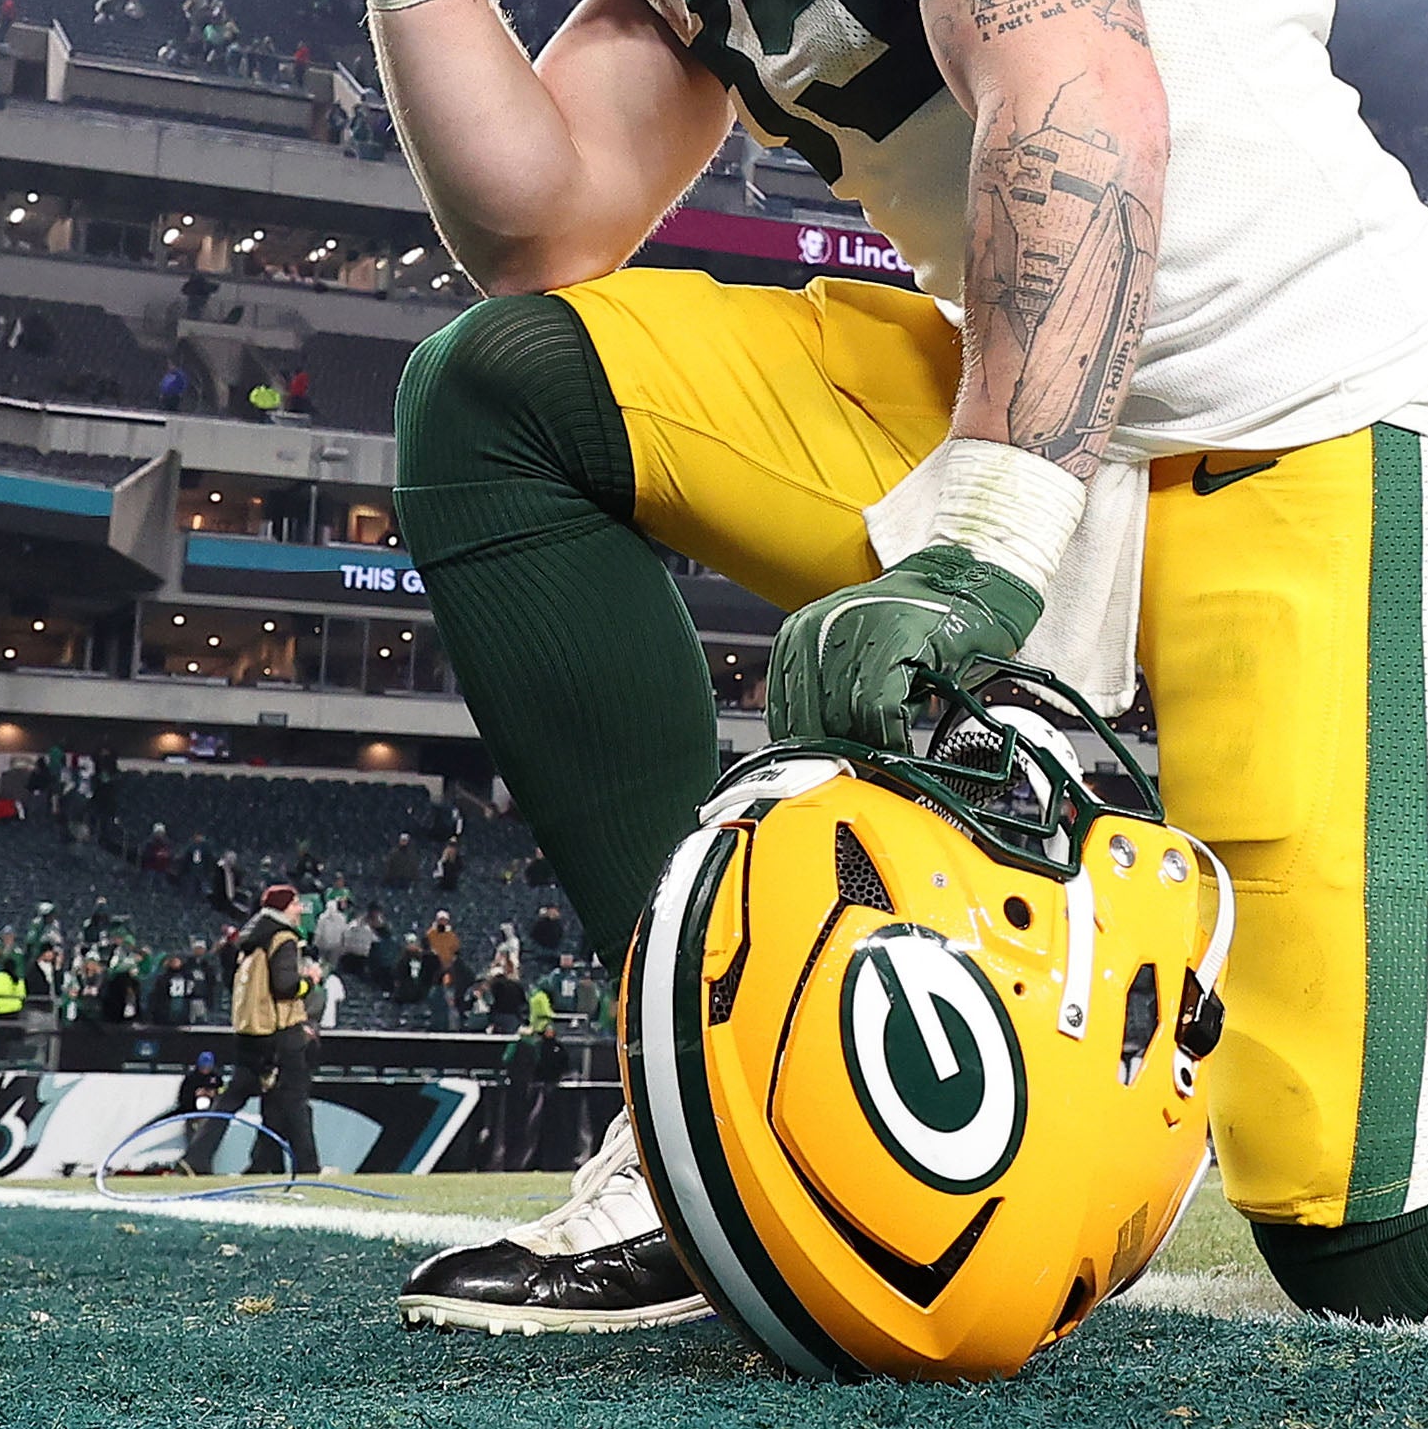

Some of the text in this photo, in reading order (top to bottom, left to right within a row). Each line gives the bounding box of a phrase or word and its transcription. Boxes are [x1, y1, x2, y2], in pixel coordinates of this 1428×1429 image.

[974, 12, 998, 29] The
[997, 13, 1033, 35] suit
[1040, 3, 1067, 20] and
[1125, 292, 1141, 334] you
[340, 564, 426, 594] THIS G
[852, 934, 1017, 1181] G
